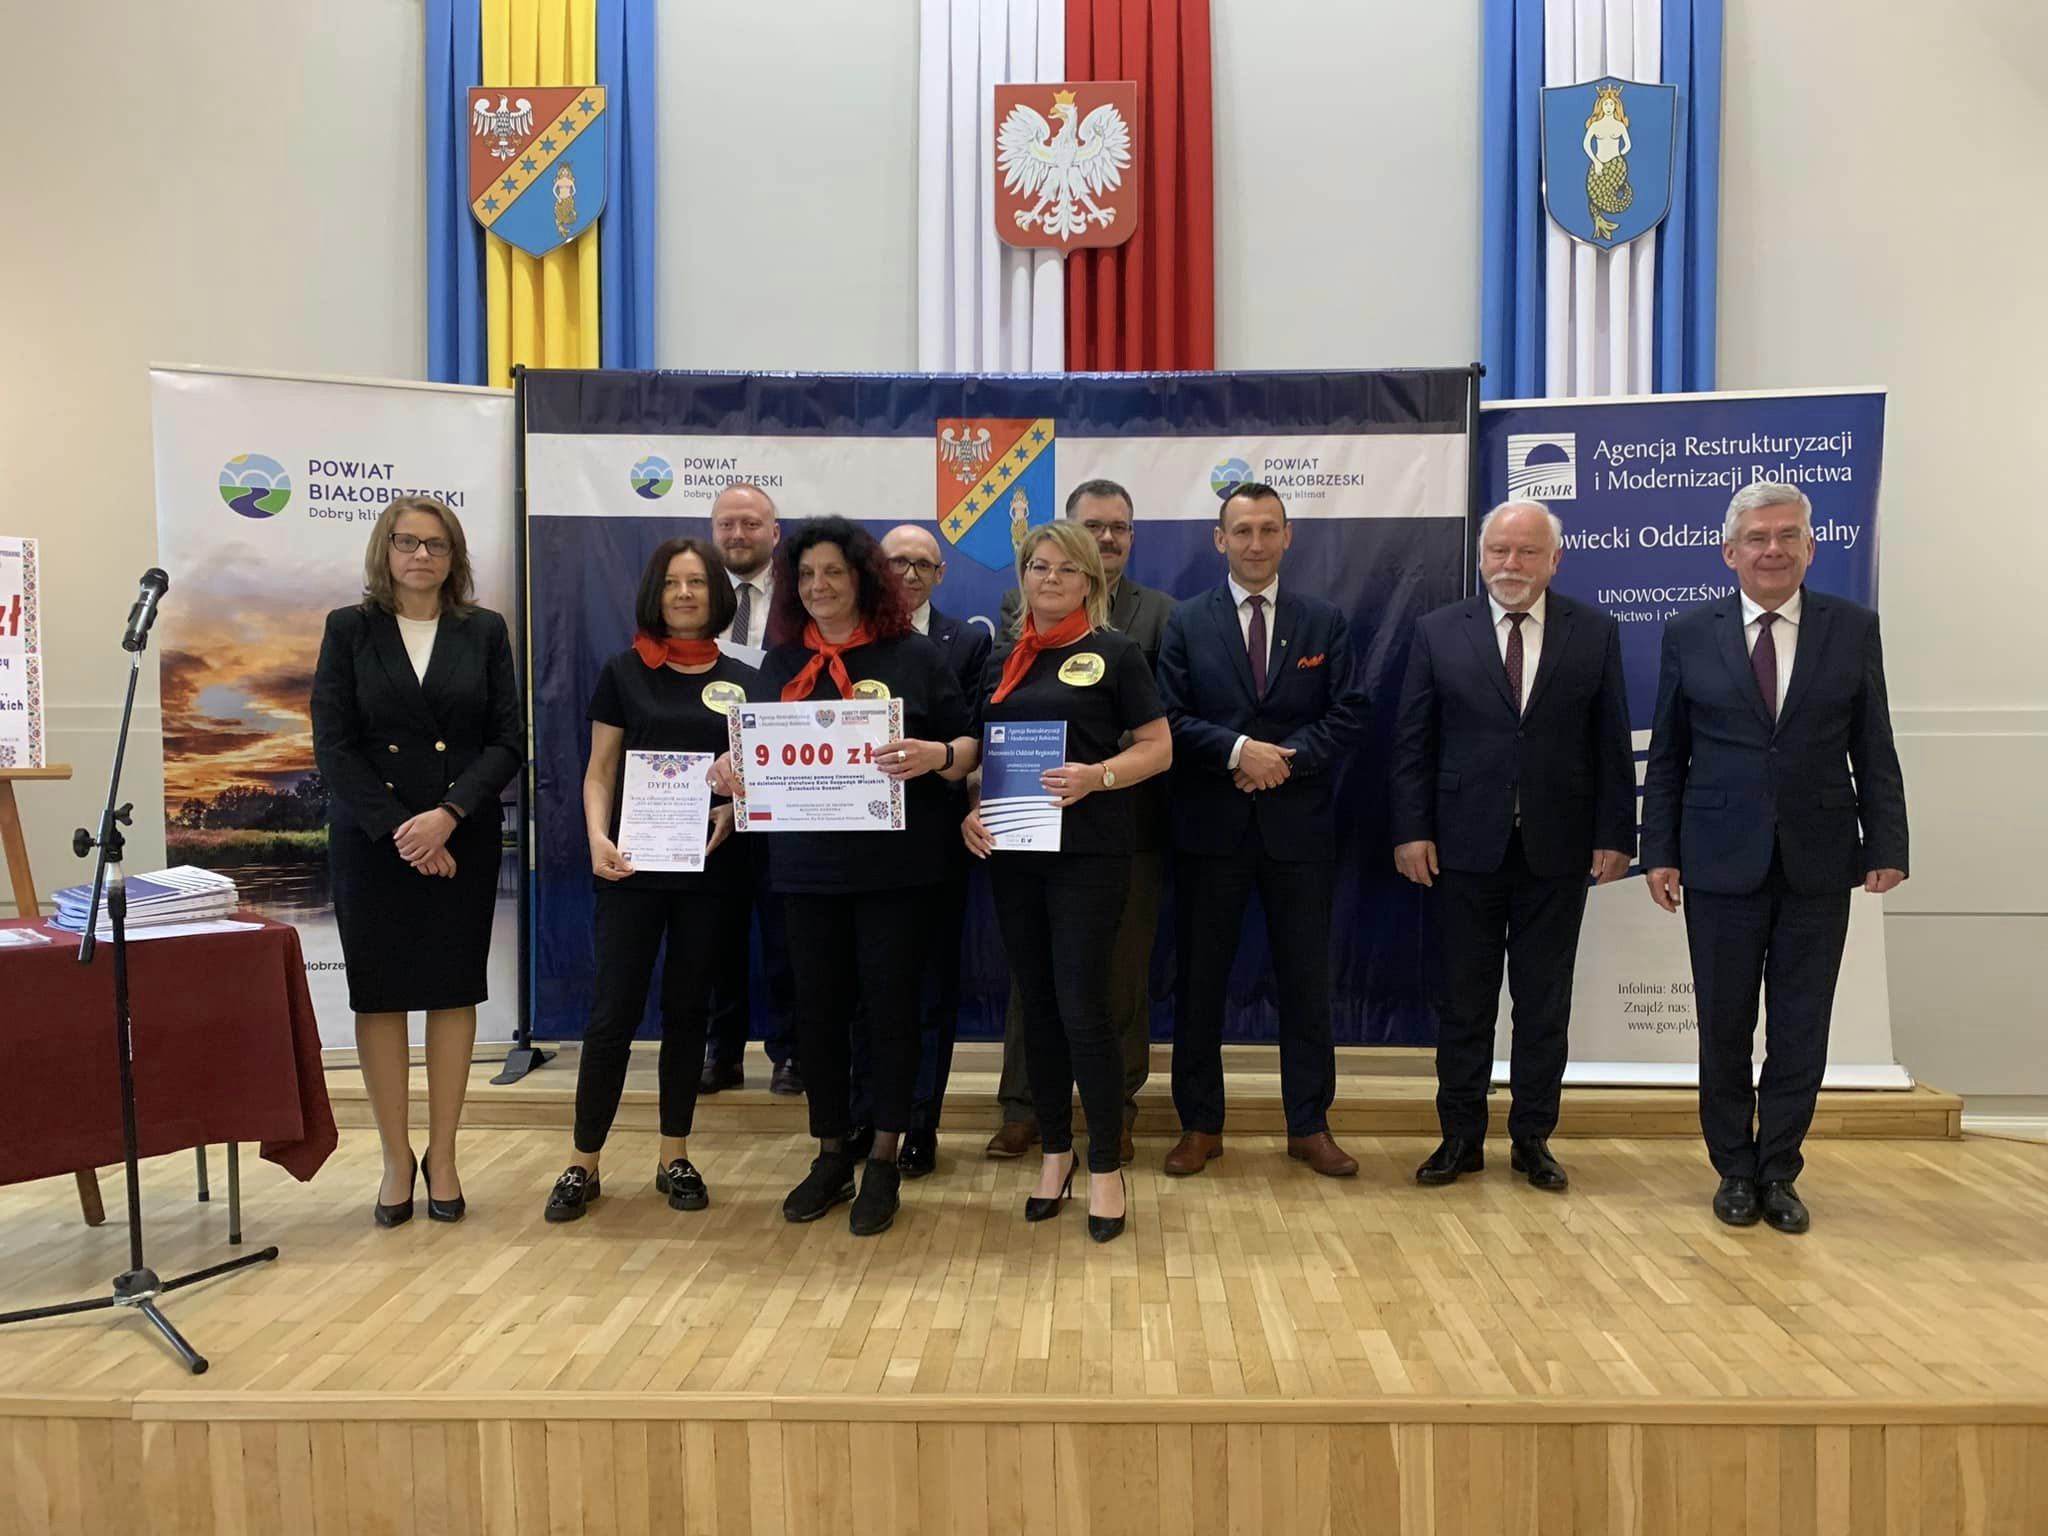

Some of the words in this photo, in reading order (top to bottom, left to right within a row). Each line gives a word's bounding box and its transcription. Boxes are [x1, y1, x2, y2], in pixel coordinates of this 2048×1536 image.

[1593, 439, 1676, 466] Agencja
[1685, 432, 1853, 459] Restrukturyzacji
[309, 459, 395, 480] POWIAT
[684, 458, 737, 470] POWIAT
[1264, 458, 1320, 470] POWIAT
[1264, 474, 1364, 486] BIAŁOBRZESKI
[1594, 472, 1600, 490] i
[1608, 467, 1743, 492] Modernizacji
[1751, 463, 1853, 484] Rolnictwa
[684, 490, 712, 500] Dobry
[1521, 484, 1573, 498] ARiMR
[309, 507, 353, 521] Dobry
[1560, 525, 1630, 550] wiecki
[1638, 522, 1727, 548] Oddział
[1598, 584, 1736, 604] UNOWOCZEŚNIA
[1610, 609, 1652, 622] nictwo
[755, 744, 770, 766] 9
[782, 743, 834, 766] 000
[847, 742, 875, 765] zł
[647, 781, 690, 790] DYPLOM
[1618, 982, 1666, 995] Infolinia:
[1671, 983, 1695, 994] 800
[1624, 1001, 1664, 1016] Znajdź
[1668, 1003, 1690, 1013] nas:
